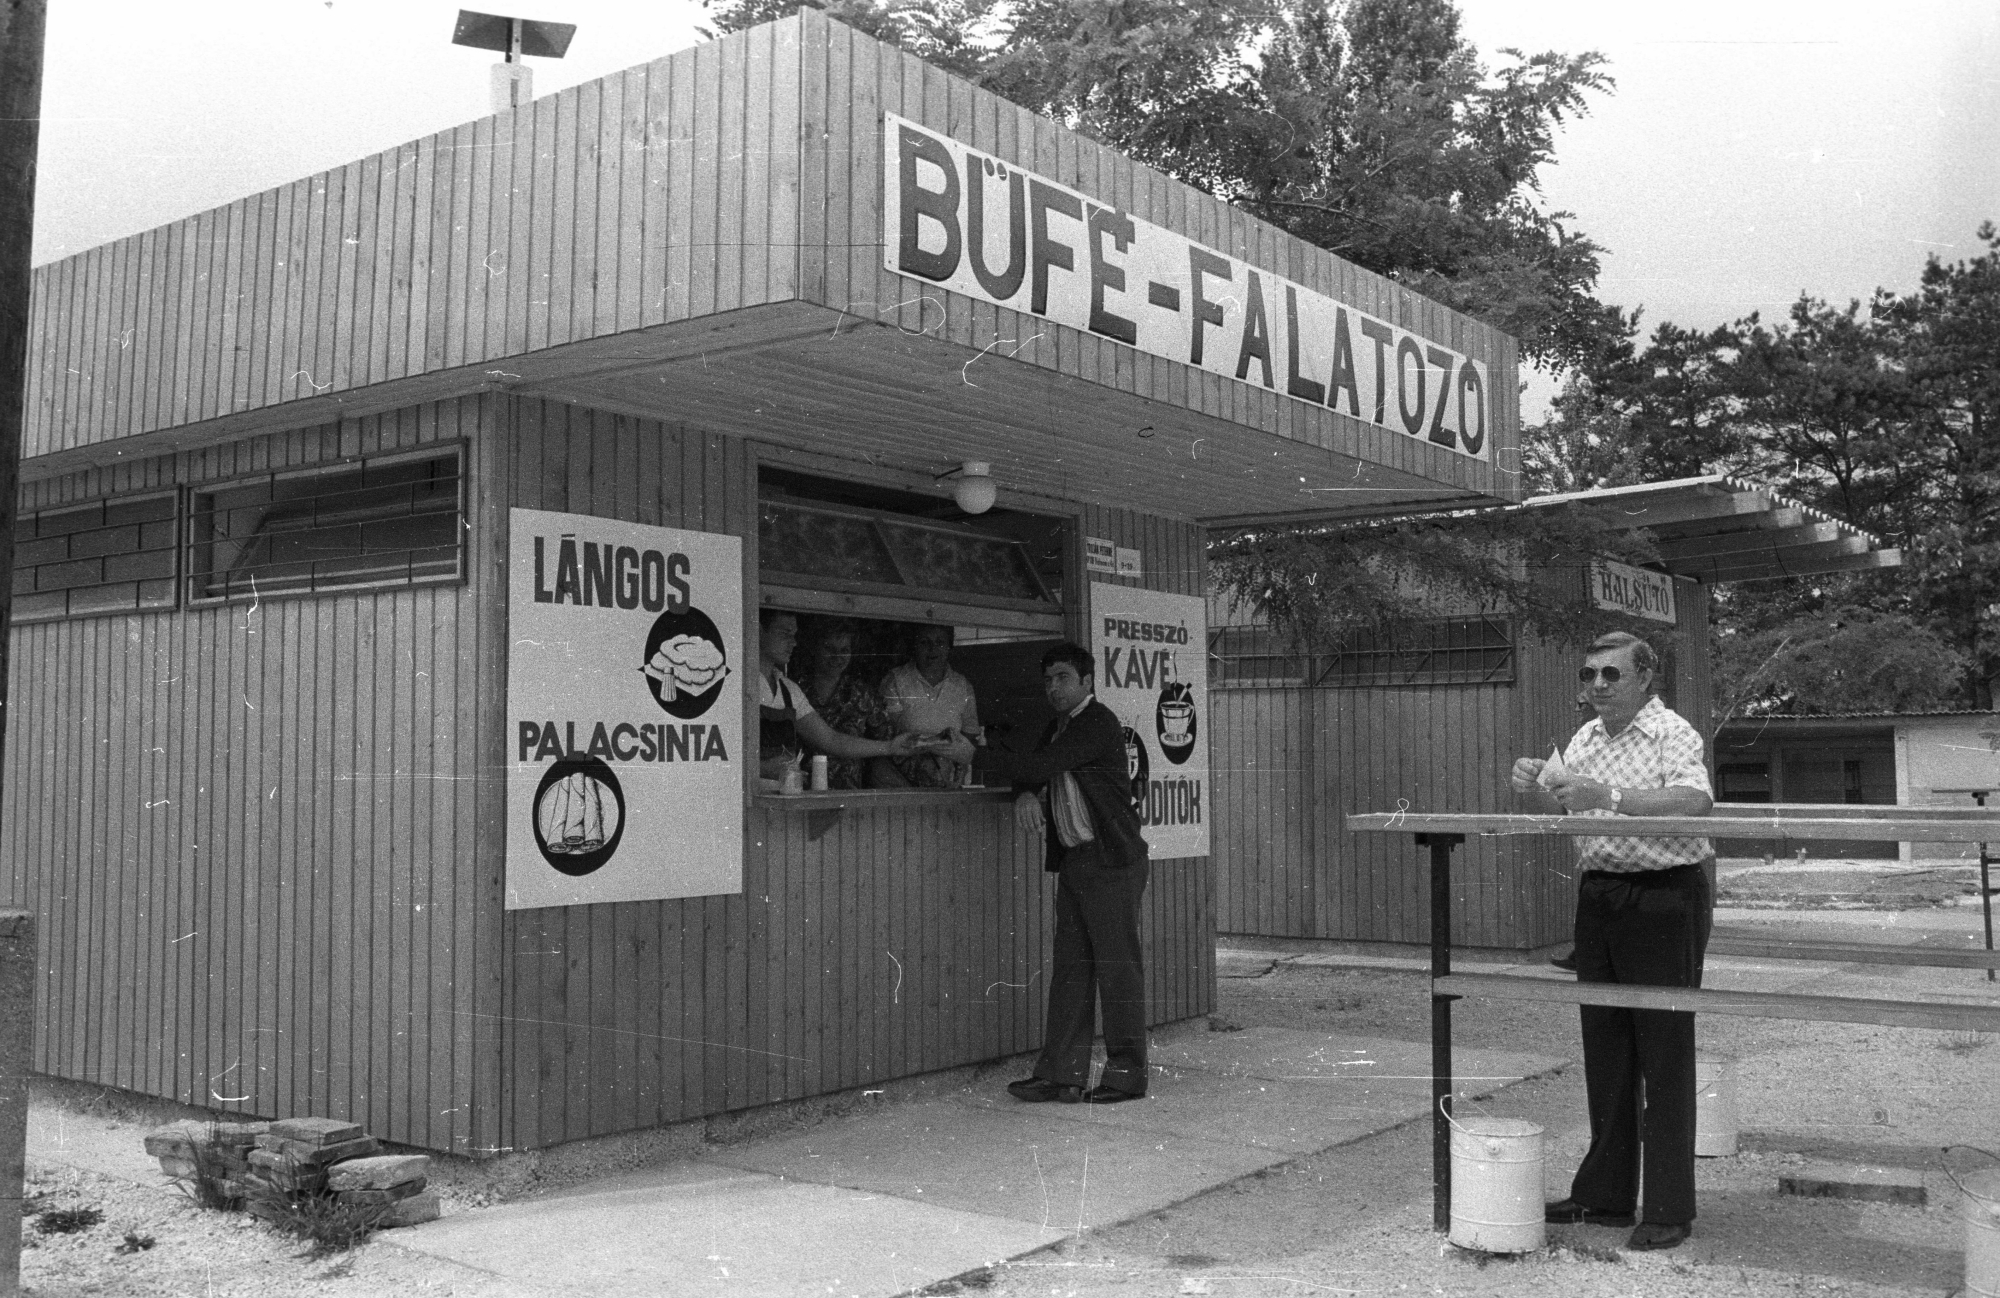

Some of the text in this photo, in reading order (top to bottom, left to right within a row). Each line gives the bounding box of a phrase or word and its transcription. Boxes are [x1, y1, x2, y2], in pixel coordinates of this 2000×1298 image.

[534, 533, 691, 615] LÁNGOS
[1104, 645, 1171, 690] KÁVÉ
[518, 720, 728, 763] PALACSINTA
